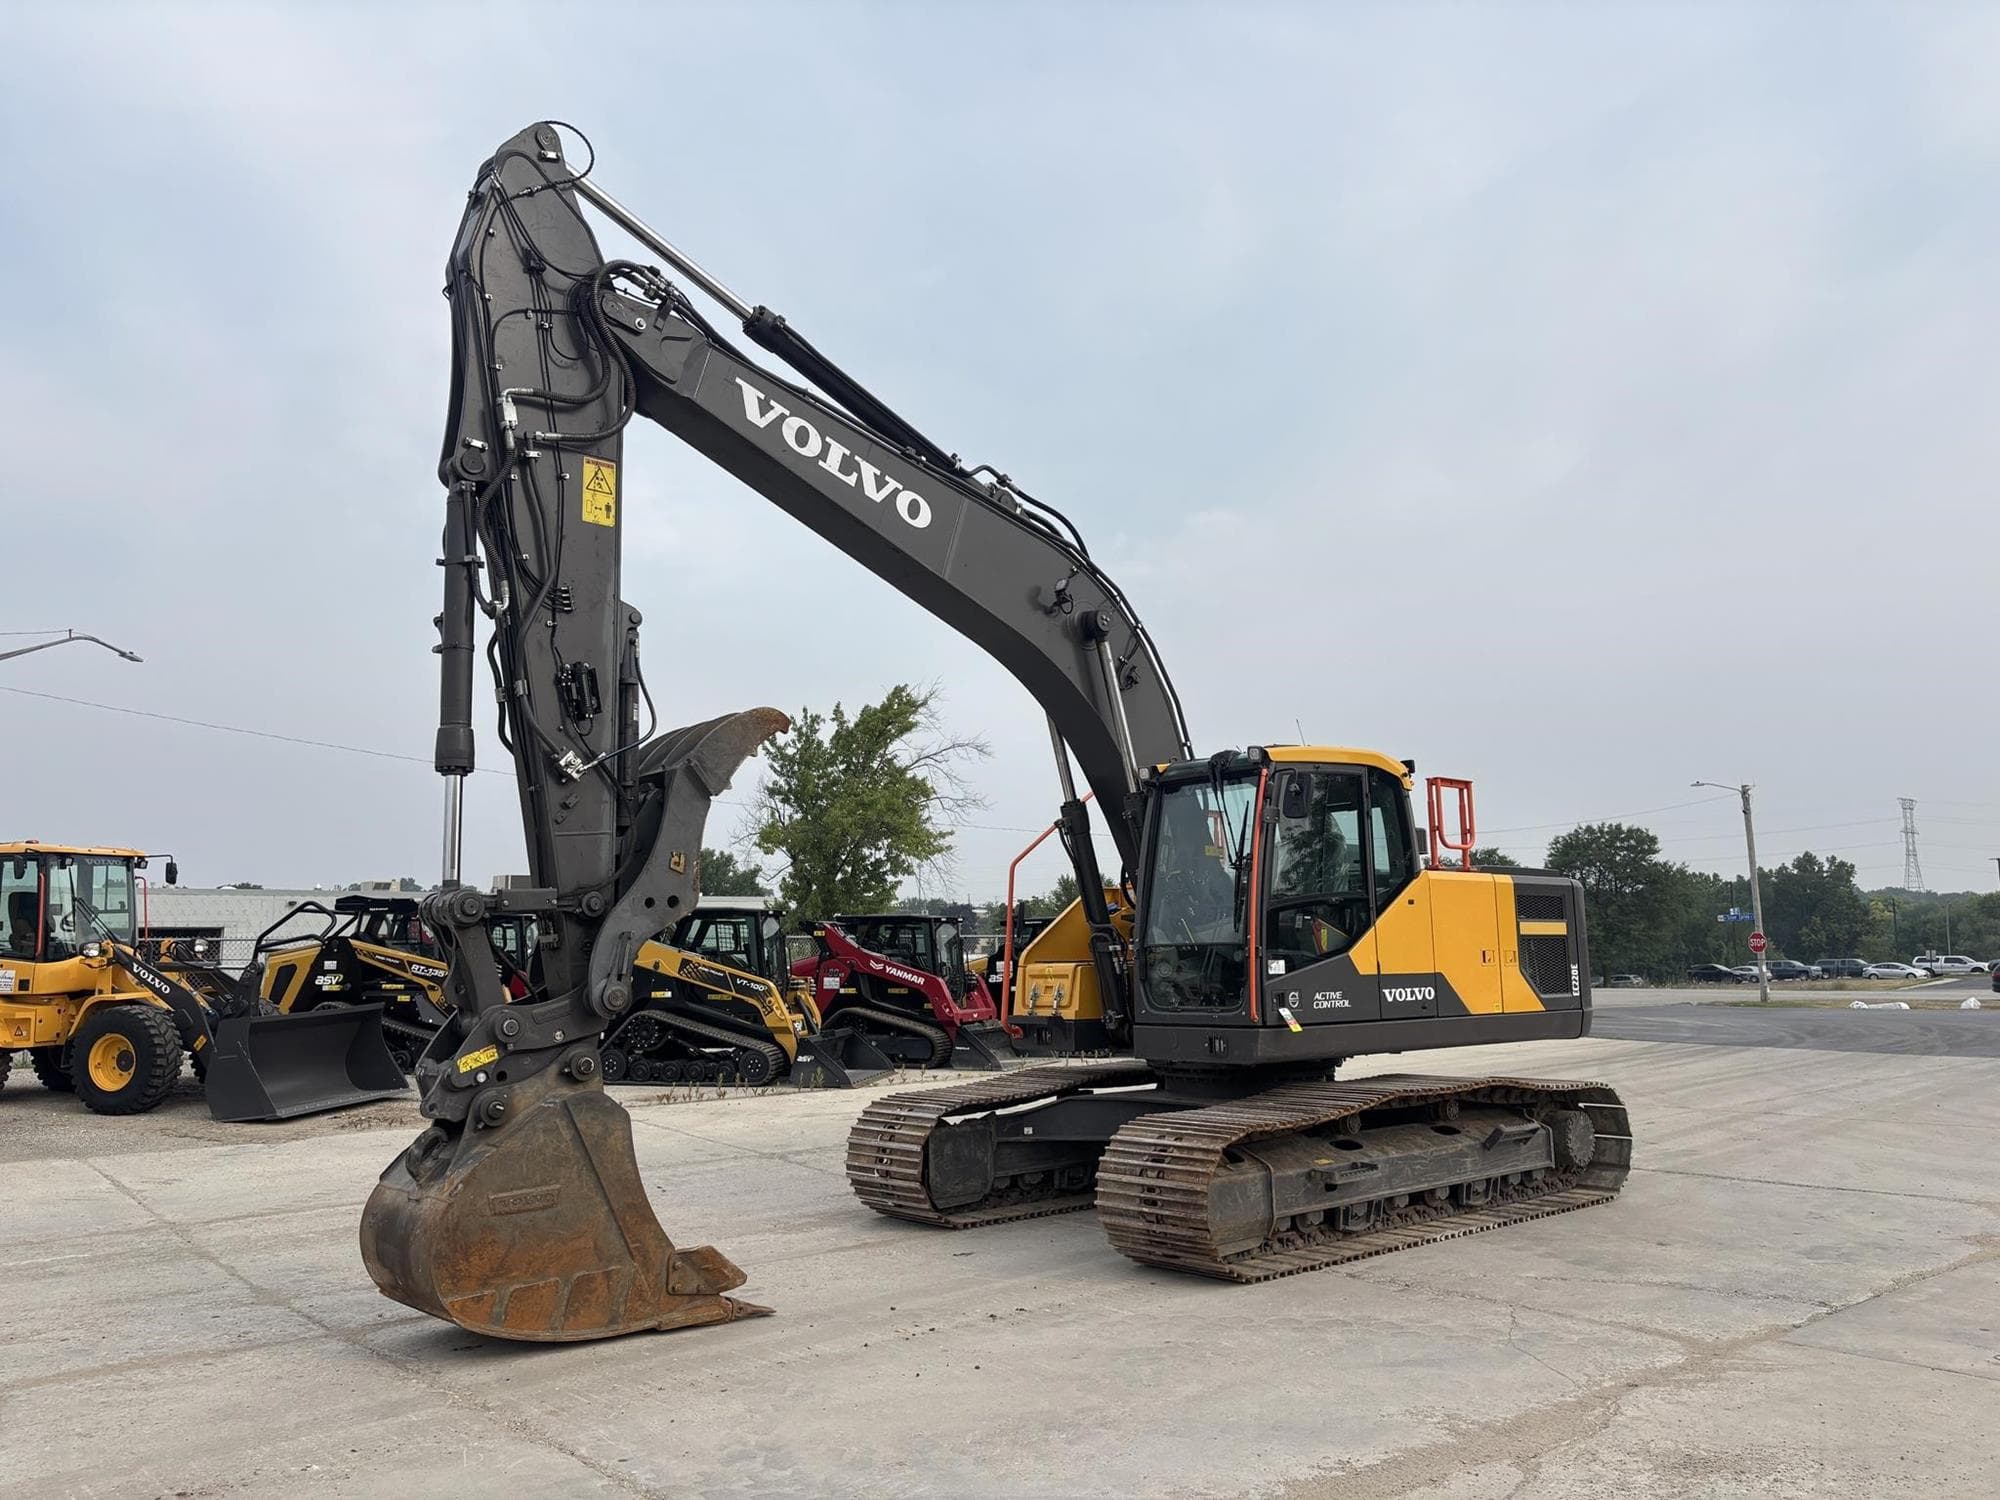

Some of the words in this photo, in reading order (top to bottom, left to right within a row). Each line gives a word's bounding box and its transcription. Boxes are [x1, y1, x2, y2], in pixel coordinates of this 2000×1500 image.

[735, 376, 932, 529] VOLVO
[1750, 938, 1766, 948] STOP
[132, 962, 171, 994] VOLVO
[885, 965, 925, 985] YANMAR
[1570, 963, 1580, 997] EC220E
[1313, 991, 1343, 1000] ACTIVE
[1382, 987, 1435, 1003] VOLVO
[1313, 1000, 1352, 1009] CONTROL
